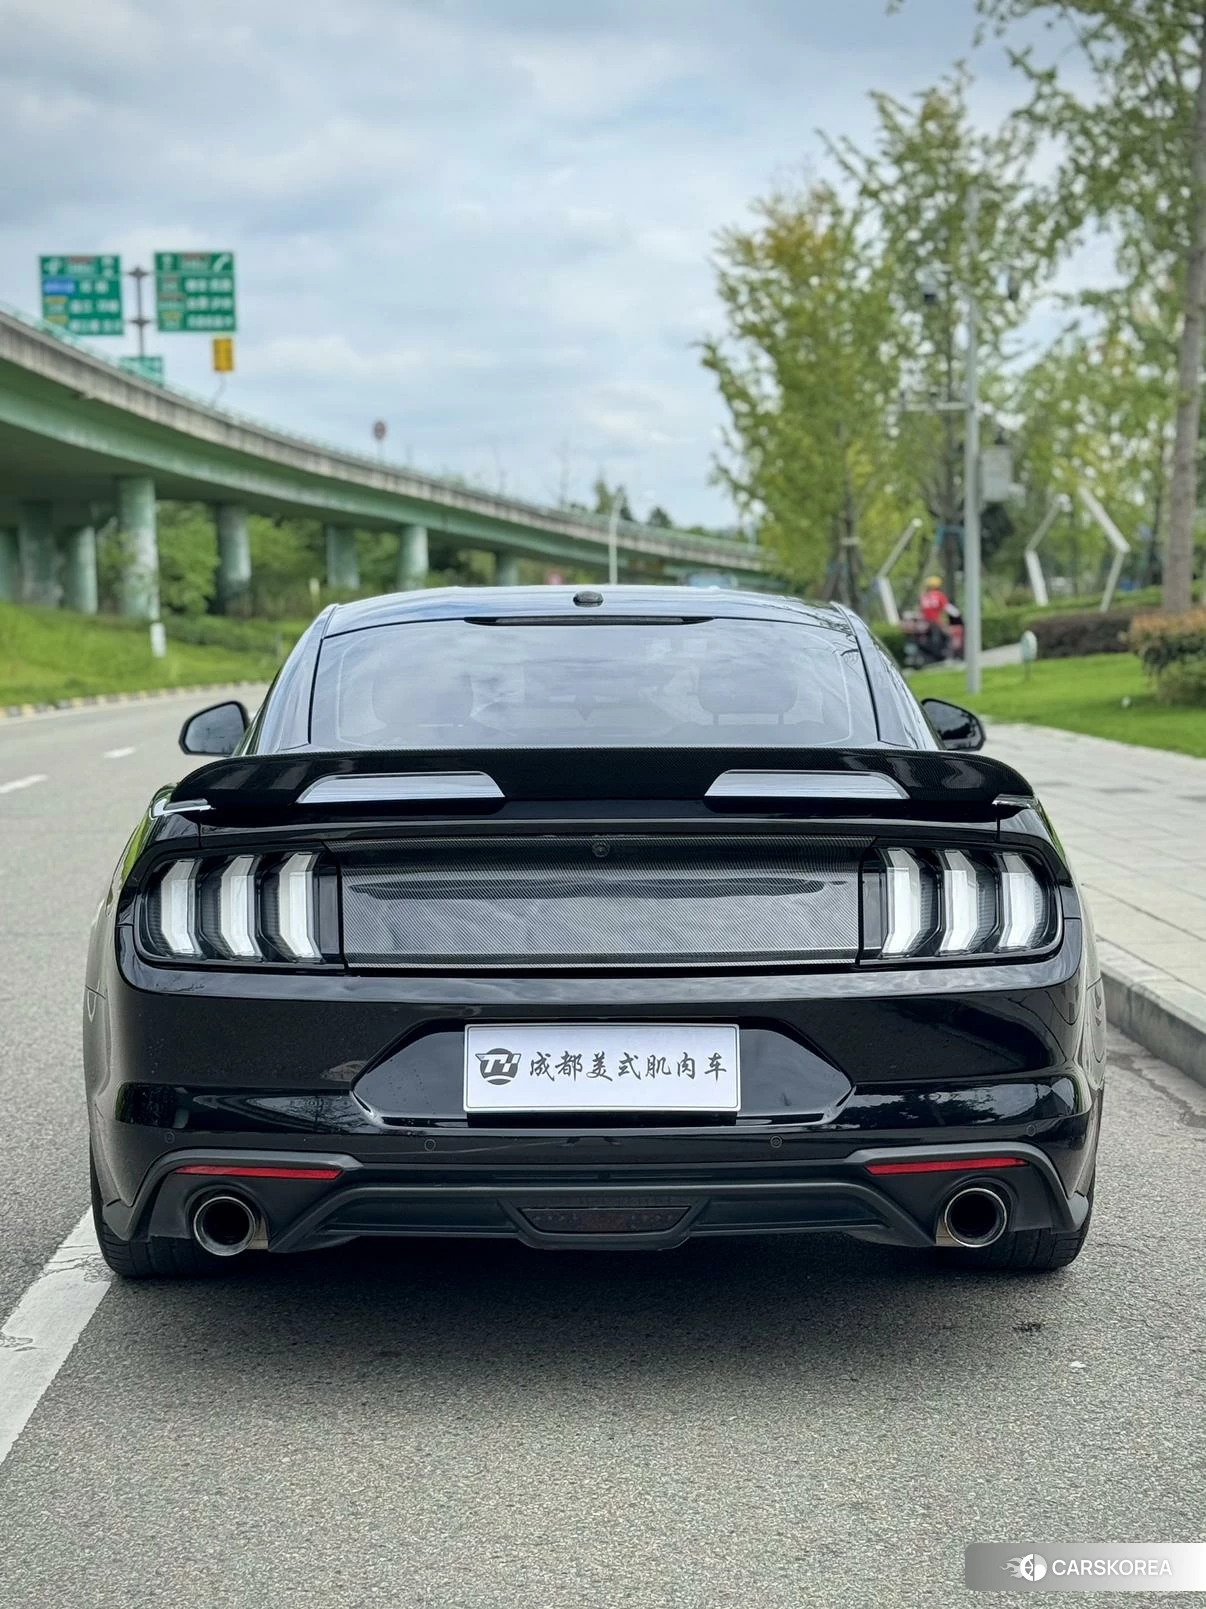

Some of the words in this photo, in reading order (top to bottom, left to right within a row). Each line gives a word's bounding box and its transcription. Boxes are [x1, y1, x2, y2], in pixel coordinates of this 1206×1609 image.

[529, 1051, 728, 1082] 成都美式肌肉车
